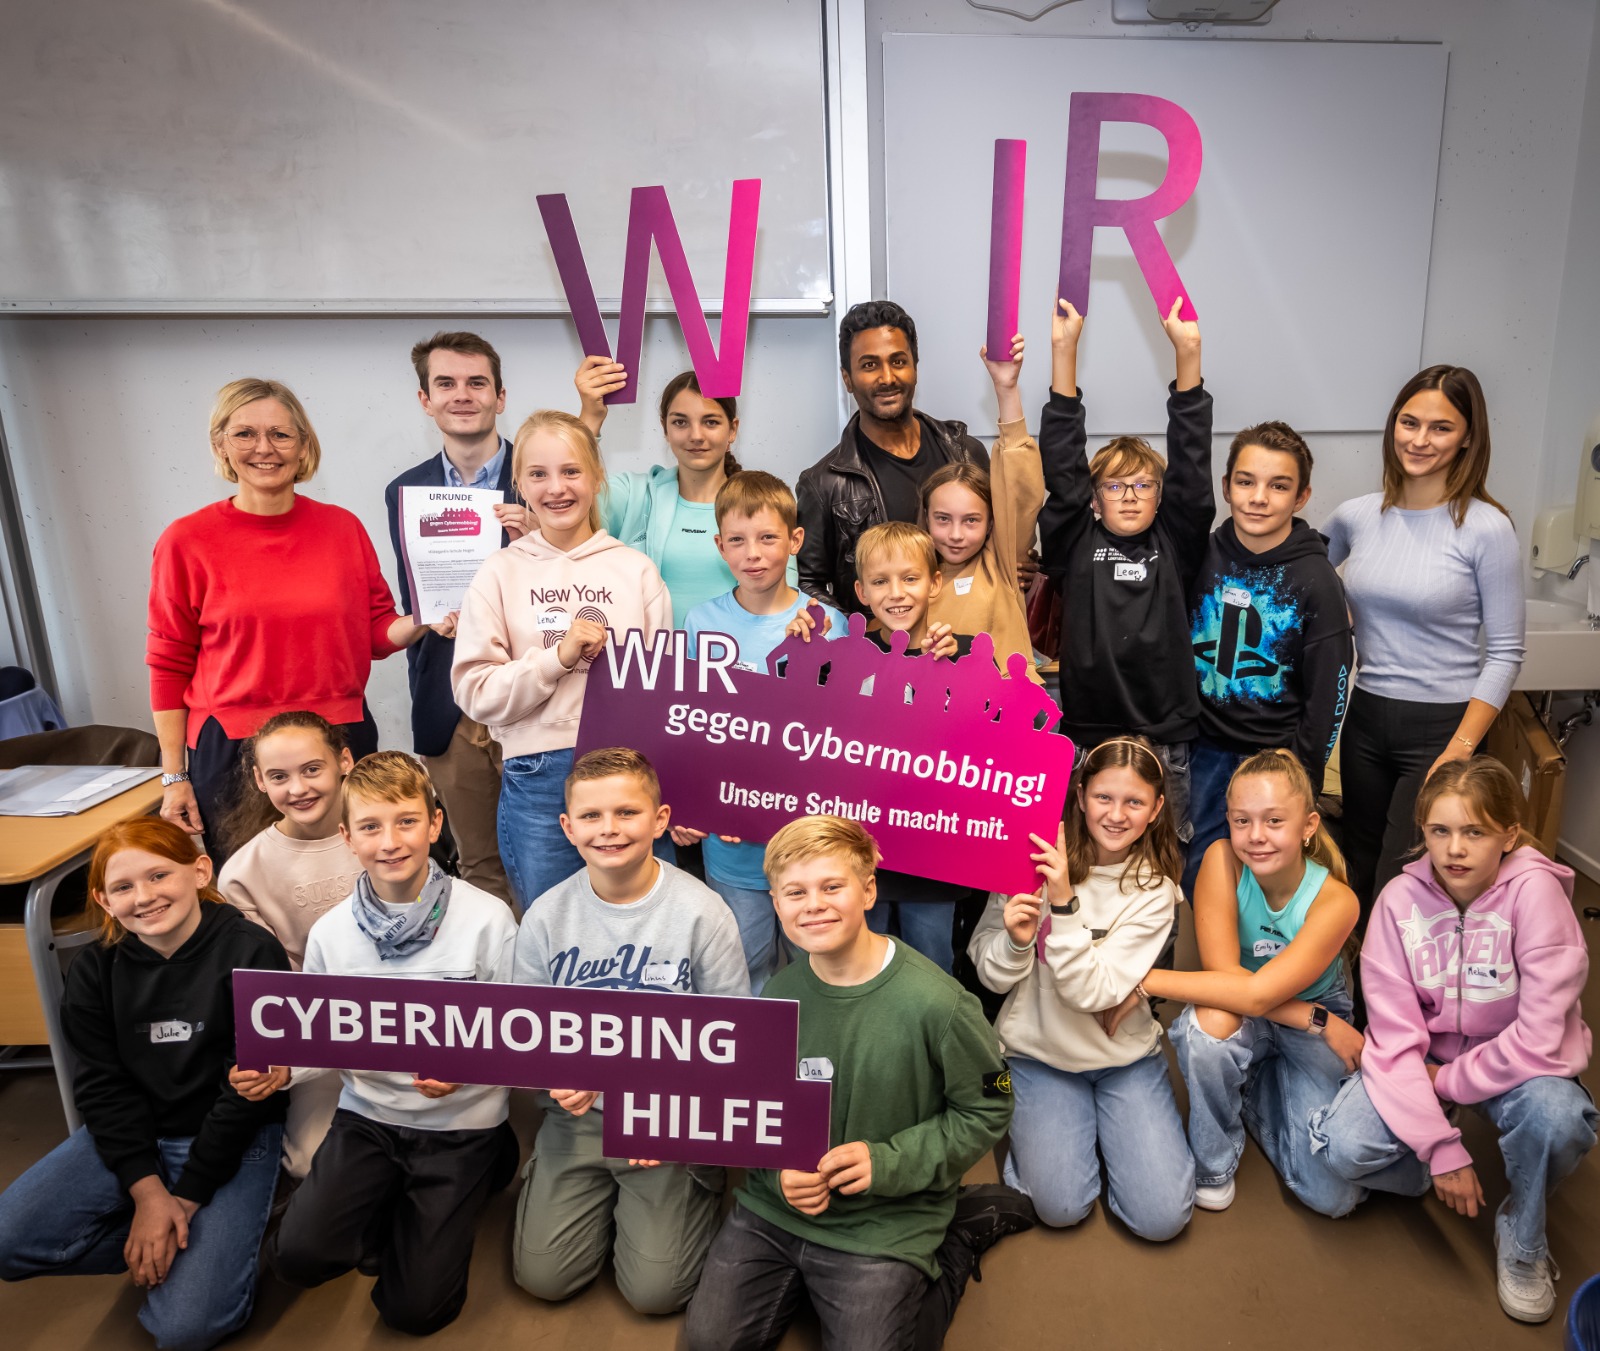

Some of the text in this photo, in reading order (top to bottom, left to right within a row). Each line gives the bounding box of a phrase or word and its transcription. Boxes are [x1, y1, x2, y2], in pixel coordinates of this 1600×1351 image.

[429, 493, 473, 502] URKUNDE
[1116, 565, 1140, 577] Leon
[530, 584, 613, 606] New York
[604, 629, 738, 694] WIR
[665, 704, 1046, 806] gegen Cybermobbing!
[719, 781, 1009, 841] Unsere Schule macht mit.
[1255, 943, 1273, 952] Emily
[550, 943, 692, 991] New Yk
[156, 1026, 180, 1039] Julie
[251, 995, 737, 1064] CYBERMOBBING
[802, 1060, 823, 1077] Jan
[623, 1091, 784, 1145] HILFE
